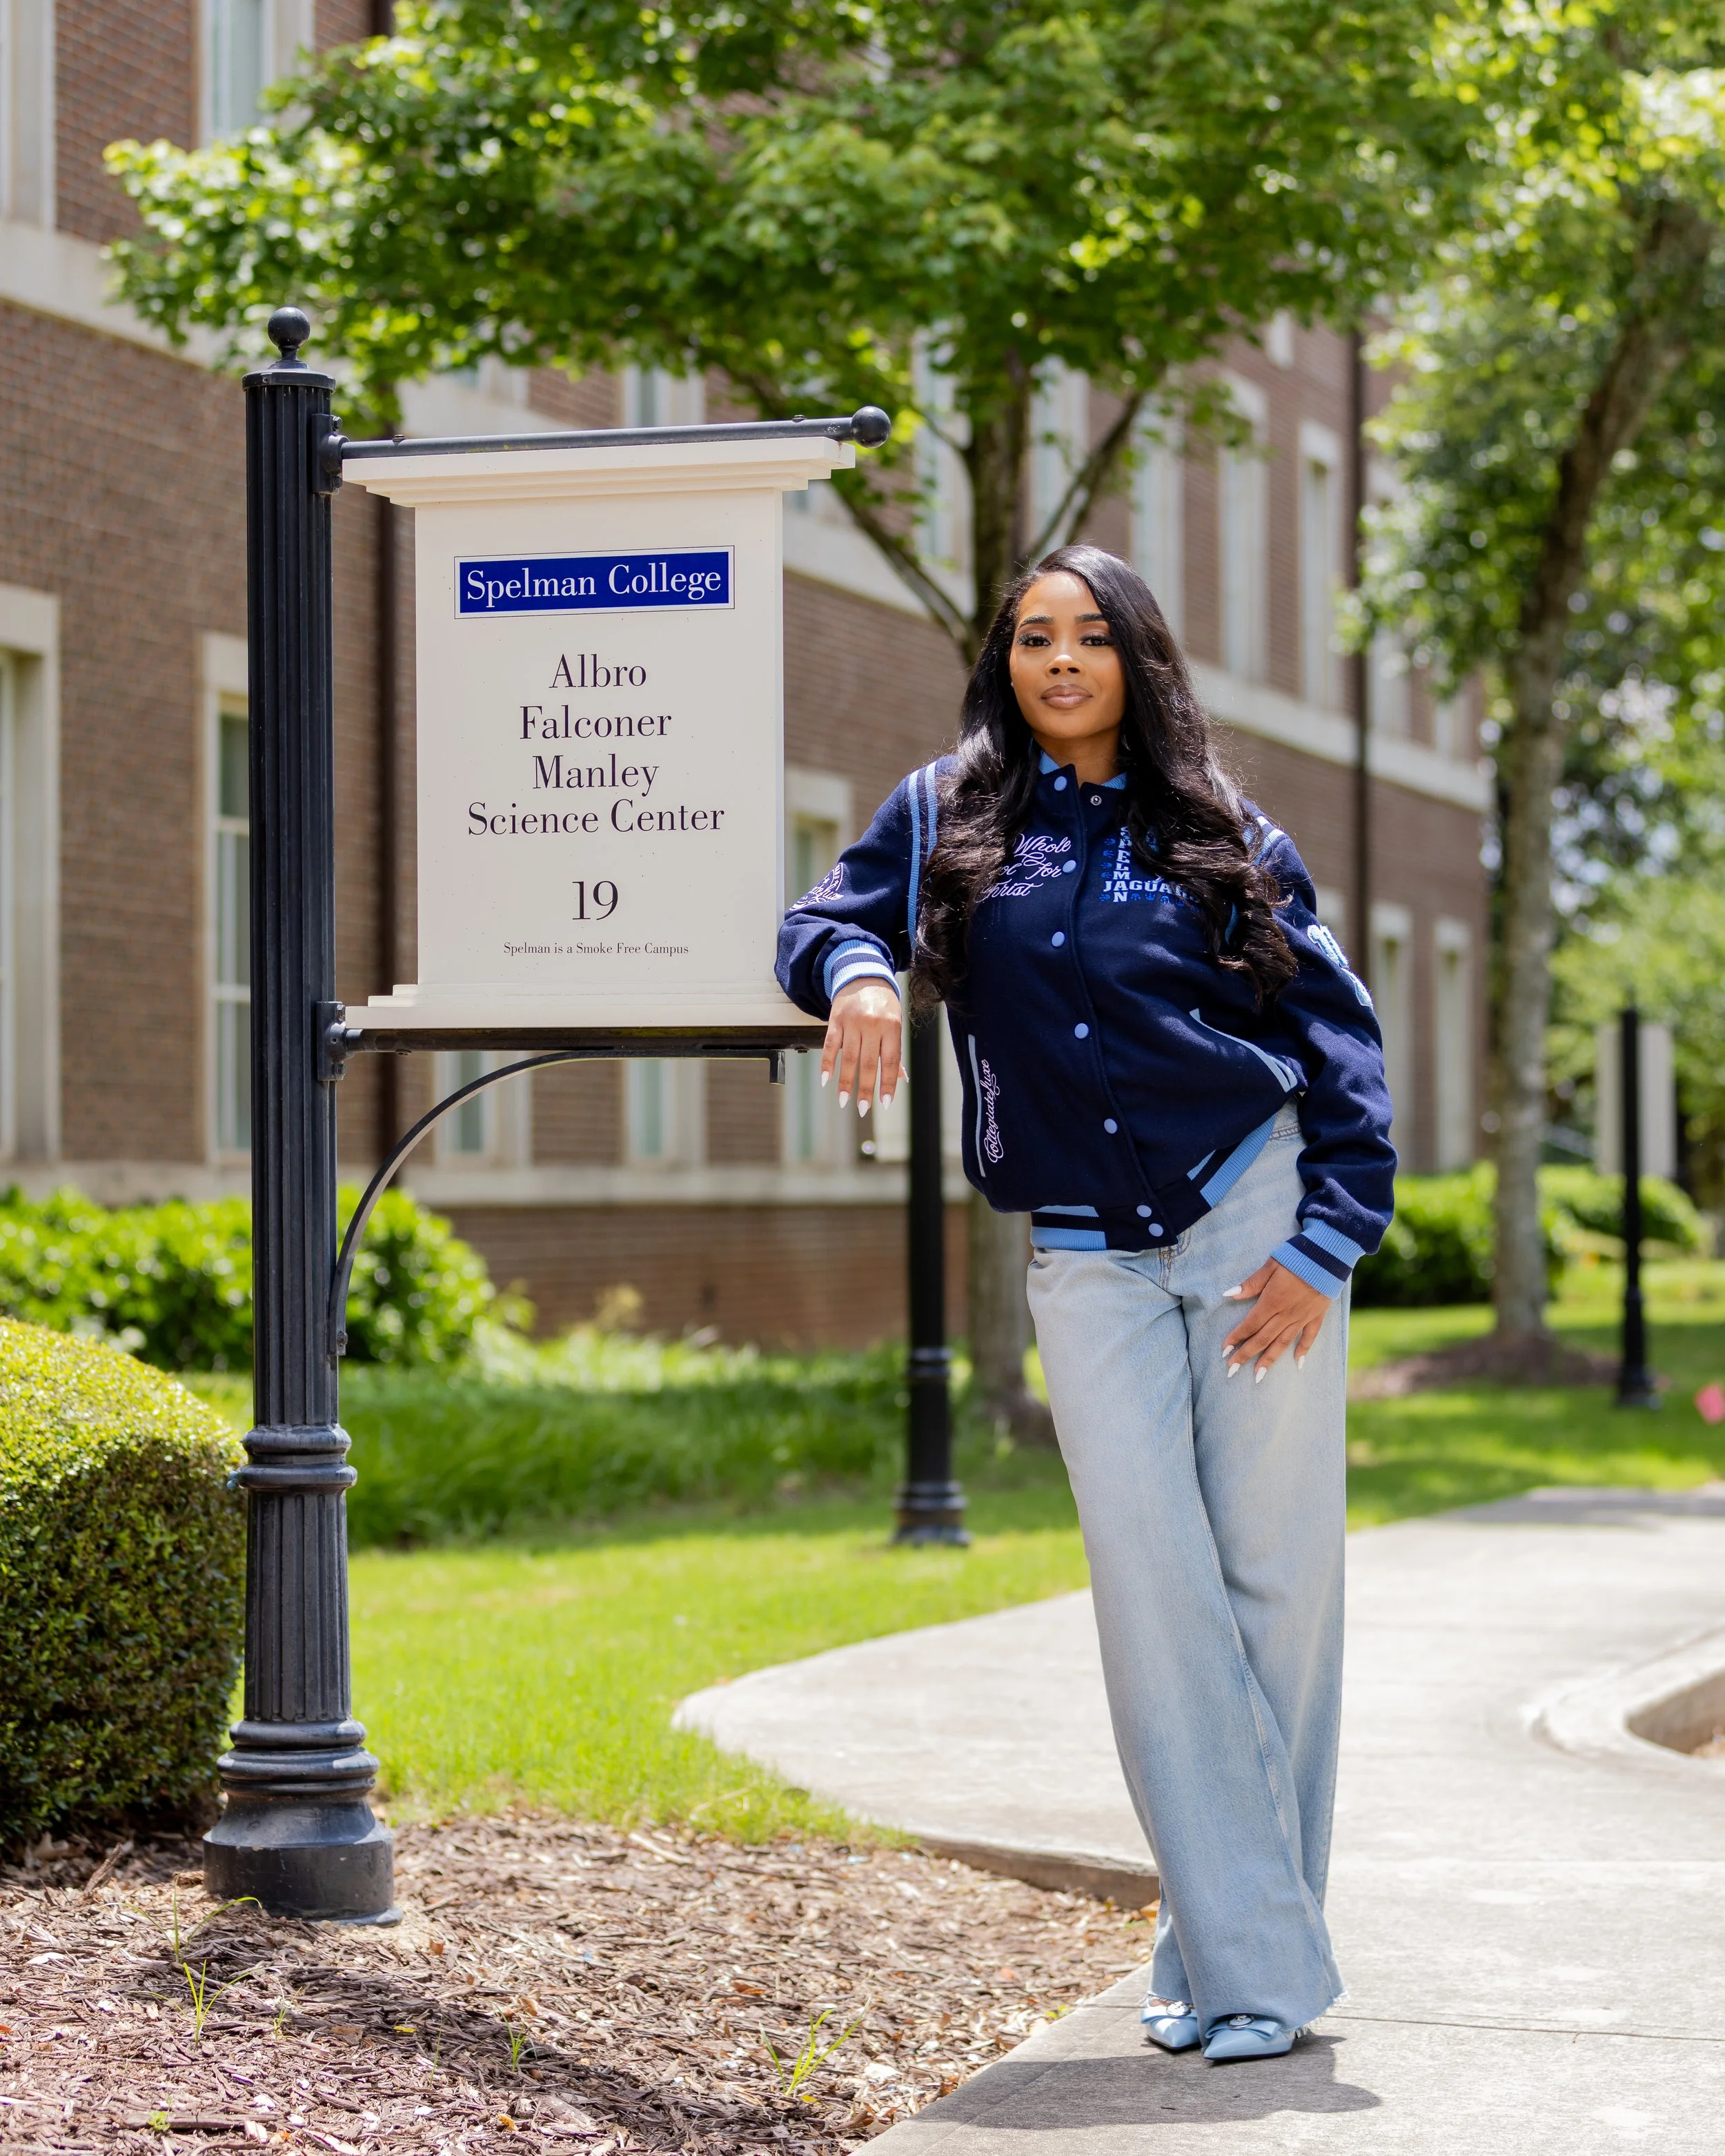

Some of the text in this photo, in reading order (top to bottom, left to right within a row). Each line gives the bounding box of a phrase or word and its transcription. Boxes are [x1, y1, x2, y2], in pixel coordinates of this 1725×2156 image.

[466, 562, 721, 608] Spelman College
[549, 653, 647, 689] Albro
[520, 704, 672, 740] Falconer
[532, 753, 660, 798] Manley
[468, 798, 725, 835] Science Center
[1012, 833, 1072, 853] Whole
[1018, 853, 1062, 880] For
[572, 880, 618, 921] 19
[503, 942, 551, 957] Spelman
[554, 942, 563, 953] is
[576, 942, 613, 953] Smoke
[616, 942, 641, 953] Free
[644, 942, 689, 957] Campus
